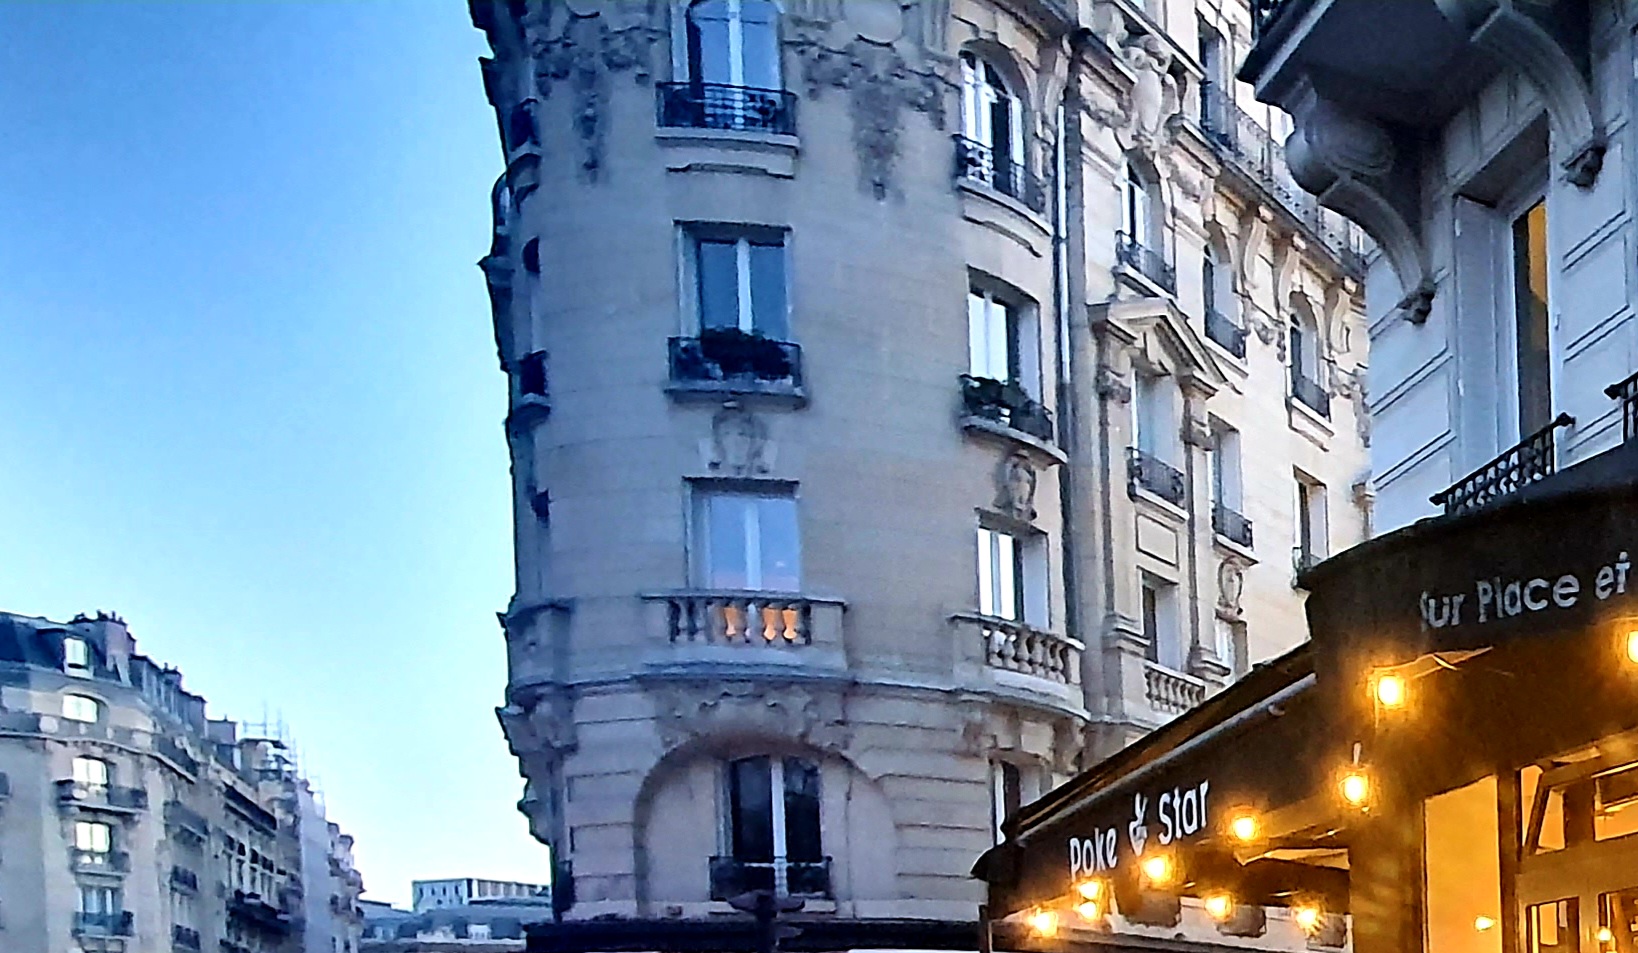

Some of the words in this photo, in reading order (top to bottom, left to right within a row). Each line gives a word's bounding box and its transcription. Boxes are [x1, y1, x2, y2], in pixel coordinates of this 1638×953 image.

[1476, 571, 1580, 622] Place
[1595, 551, 1628, 598] et
[1158, 779, 1209, 845] Star
